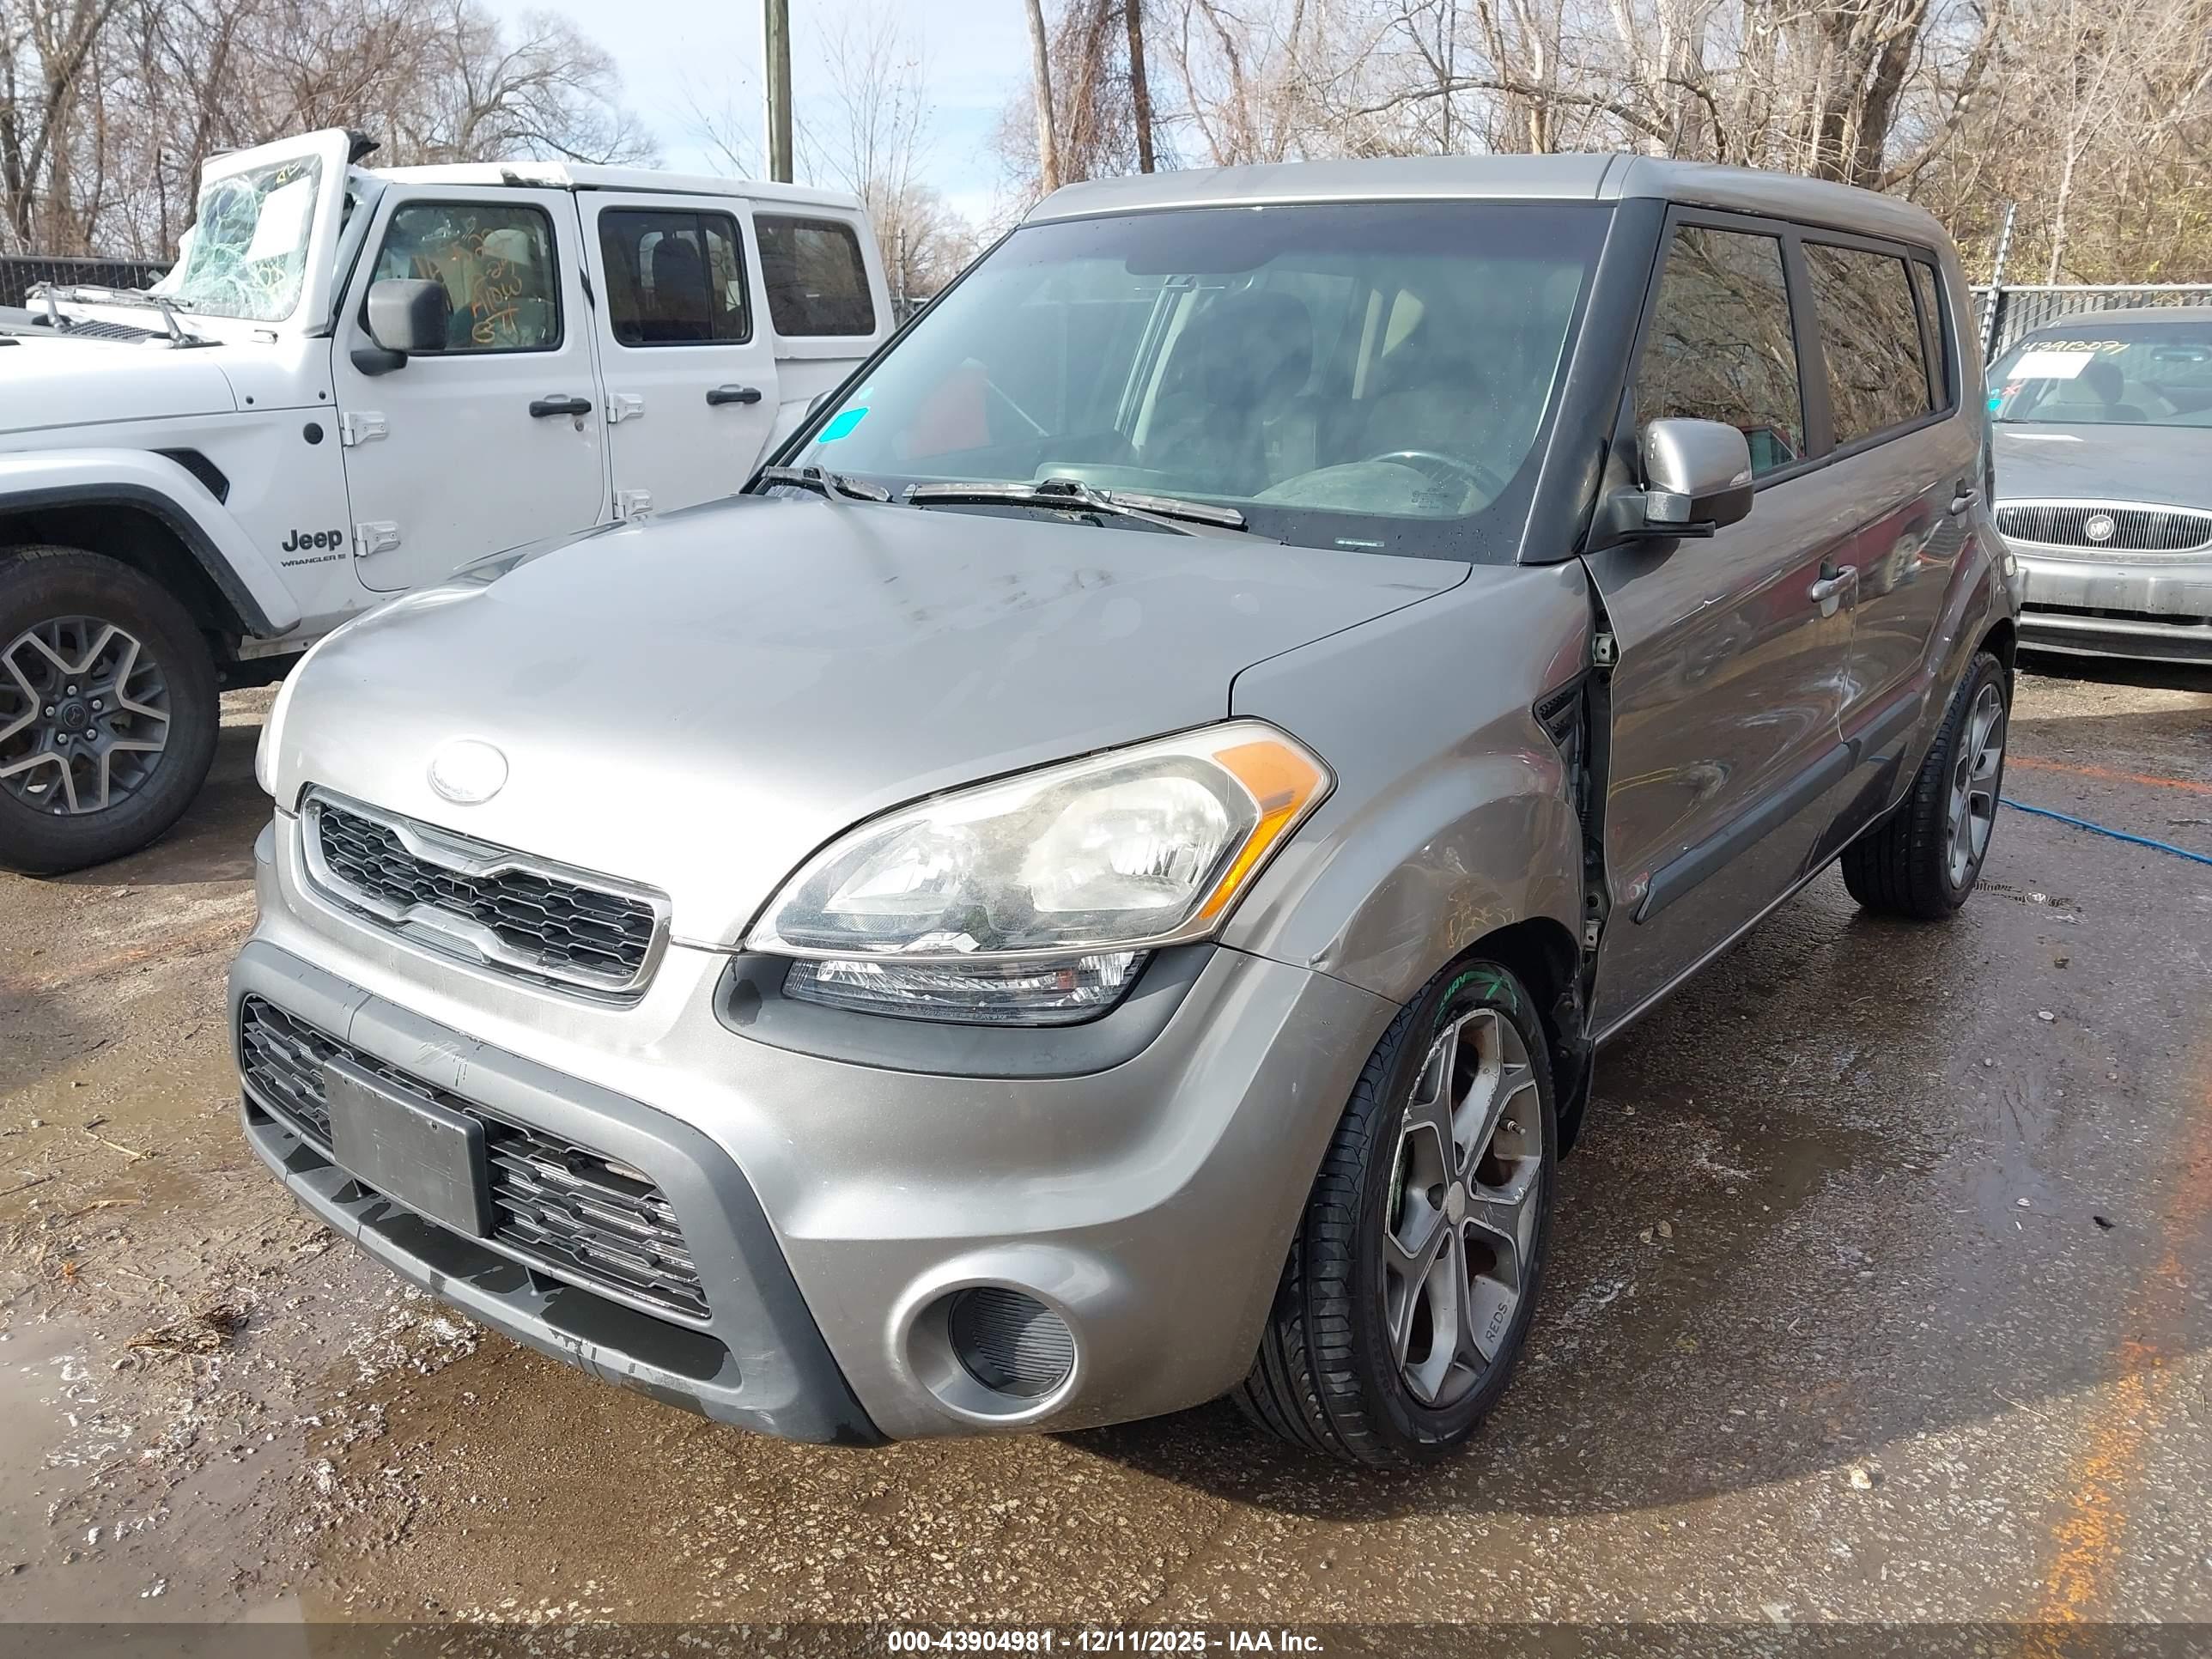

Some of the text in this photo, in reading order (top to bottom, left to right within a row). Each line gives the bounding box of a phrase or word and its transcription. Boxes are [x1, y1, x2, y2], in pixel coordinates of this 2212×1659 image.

[282, 528, 343, 552] Jeep
[280, 554, 337, 567] WRANGLER
[1486, 1303, 1508, 1344] REDS
